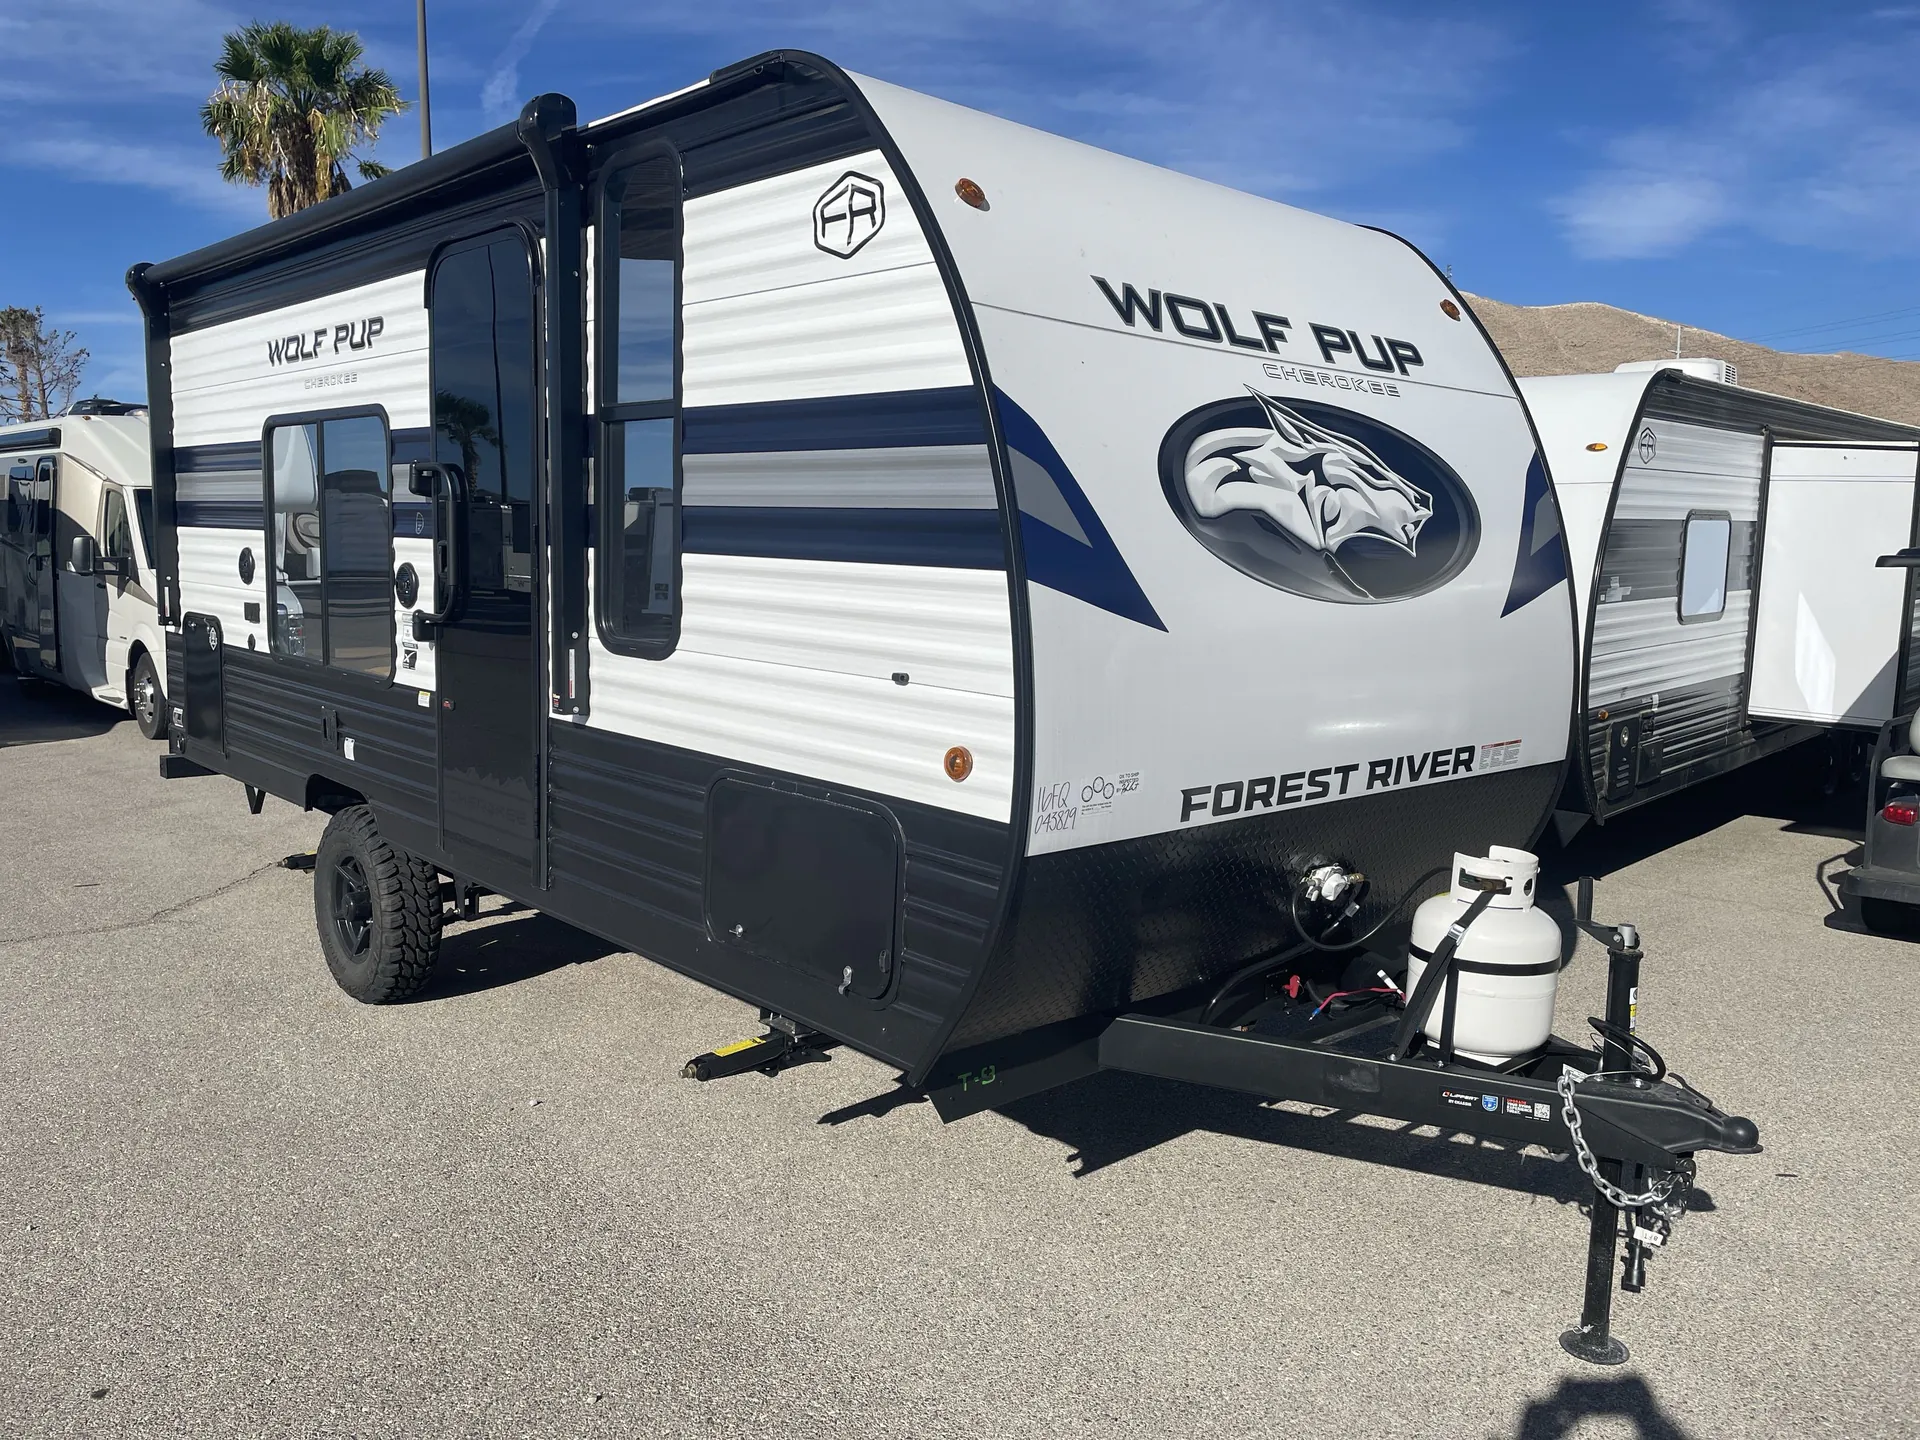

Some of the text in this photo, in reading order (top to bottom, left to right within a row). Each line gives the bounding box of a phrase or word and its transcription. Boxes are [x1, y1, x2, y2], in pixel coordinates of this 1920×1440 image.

[267, 315, 384, 367] WOLF PUP
[1090, 275, 1424, 376] WOLF PUP
[305, 372, 357, 390] CHEROKEE
[1263, 363, 1400, 398] CHEROKEE
[1180, 763, 1359, 823] FOREST
[1366, 745, 1476, 790] RIVER
[1034, 806, 1077, 834] 043829
[957, 1065, 996, 1092] T-9
